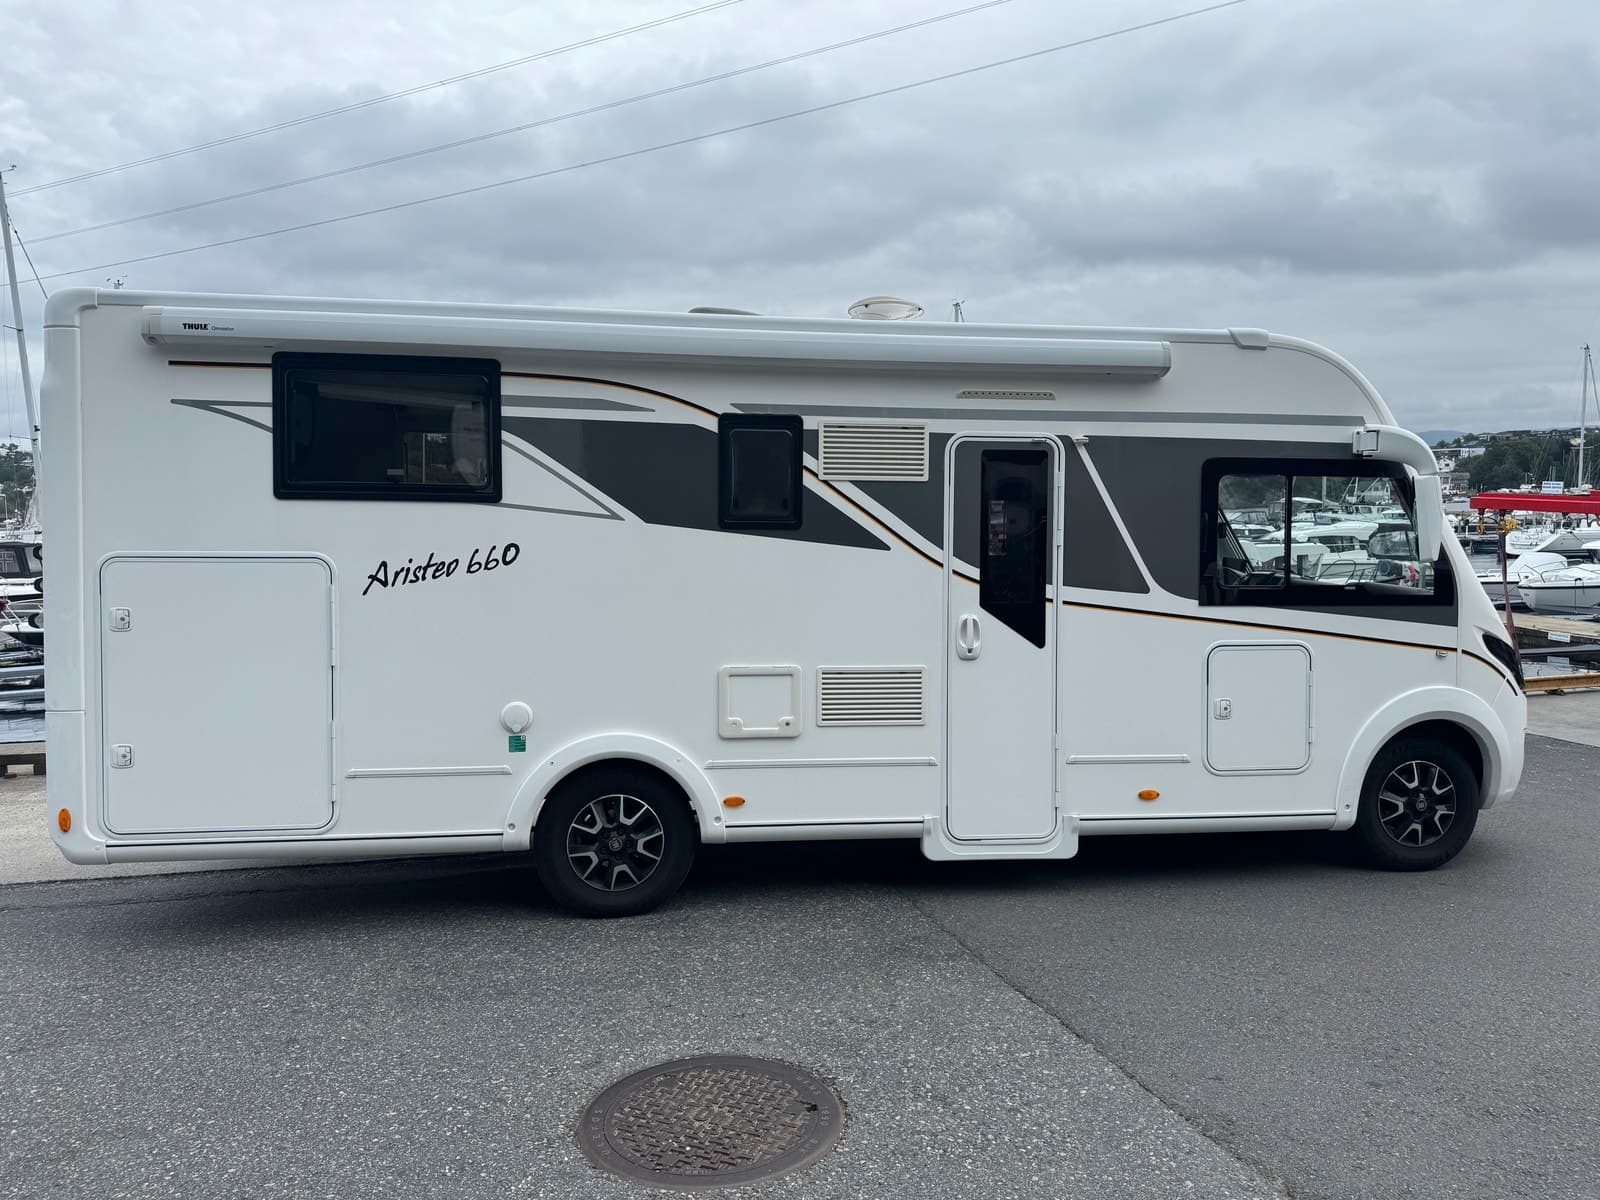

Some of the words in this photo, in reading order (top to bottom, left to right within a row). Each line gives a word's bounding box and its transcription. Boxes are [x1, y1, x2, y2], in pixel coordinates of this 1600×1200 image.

[182, 322, 209, 331] THULE
[362, 552, 460, 596] Aristeo
[466, 542, 521, 574] 660
